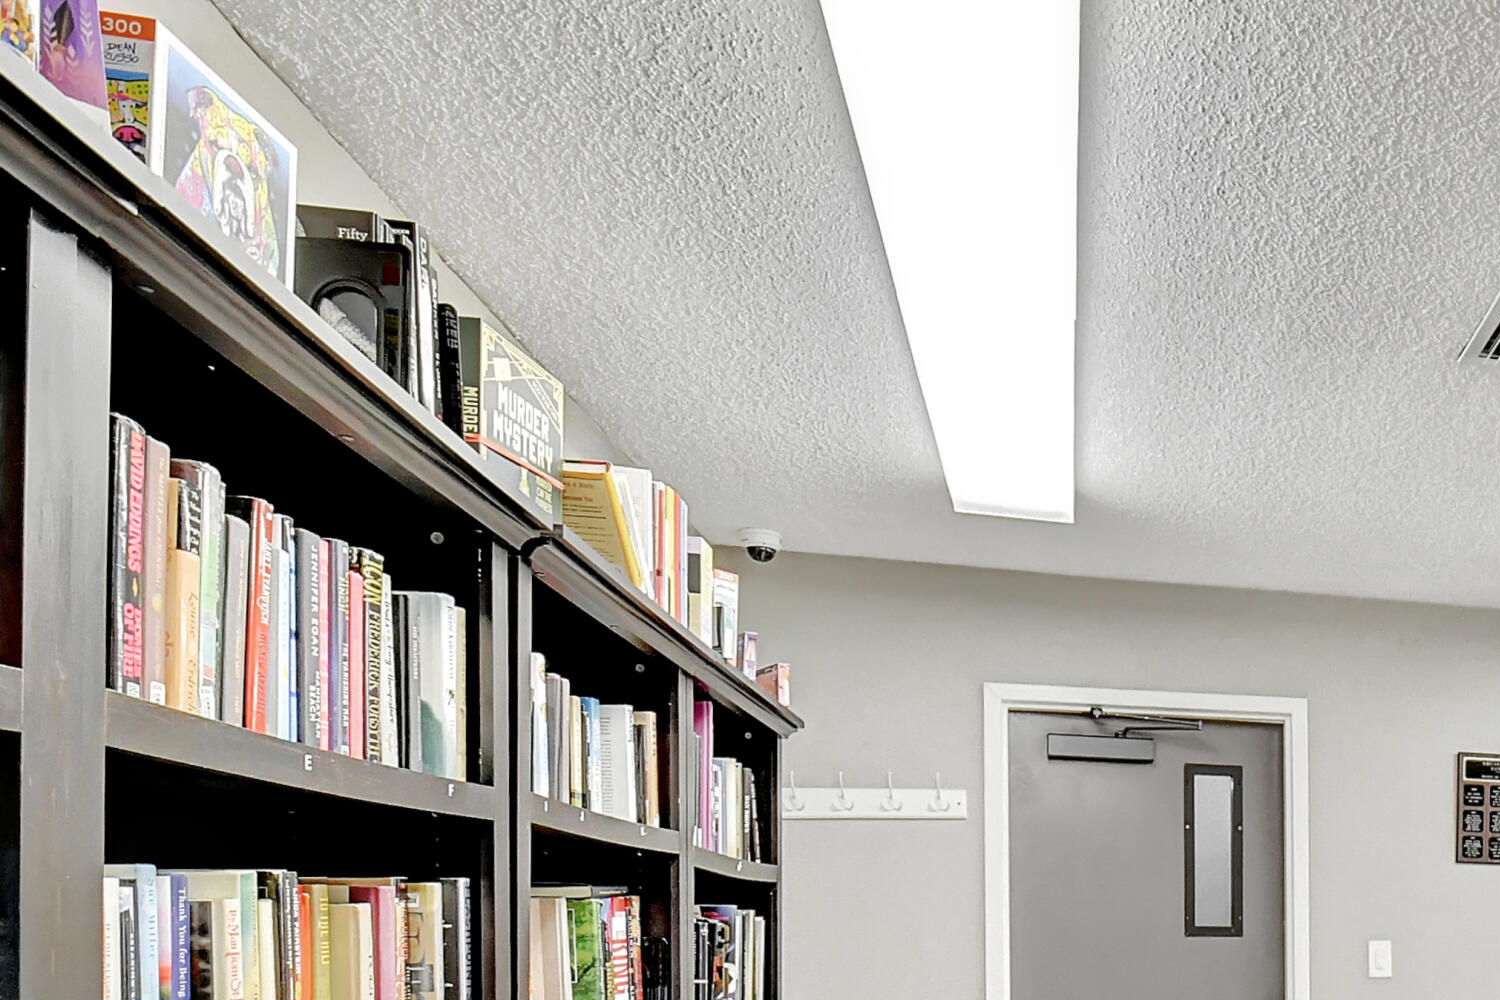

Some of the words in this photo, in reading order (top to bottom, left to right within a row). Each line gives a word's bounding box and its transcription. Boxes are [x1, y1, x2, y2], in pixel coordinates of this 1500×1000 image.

[102, 17, 142, 35] 300
[337, 227, 368, 241] Fifty
[498, 382, 550, 444] MURDER
[128, 430, 145, 489] DAVID
[493, 408, 554, 474] MYSTERY
[127, 490, 144, 573] EDDINGS
[310, 545, 320, 613] JENNIFER
[362, 557, 383, 605] ICON
[123, 602, 134, 631] OF
[257, 573, 271, 626] EVANOVICH
[123, 632, 134, 678] FIRE
[310, 618, 319, 657] EGAN
[369, 610, 382, 691] FREDERICK
[309, 685, 317, 722] BEACH
[369, 695, 382, 756] FORSYTH
[305, 754, 312, 770] E
[448, 784, 454, 797] F
[178, 887, 187, 921] Thank
[178, 924, 187, 945] You
[178, 948, 187, 964] for
[177, 967, 188, 997] Being
